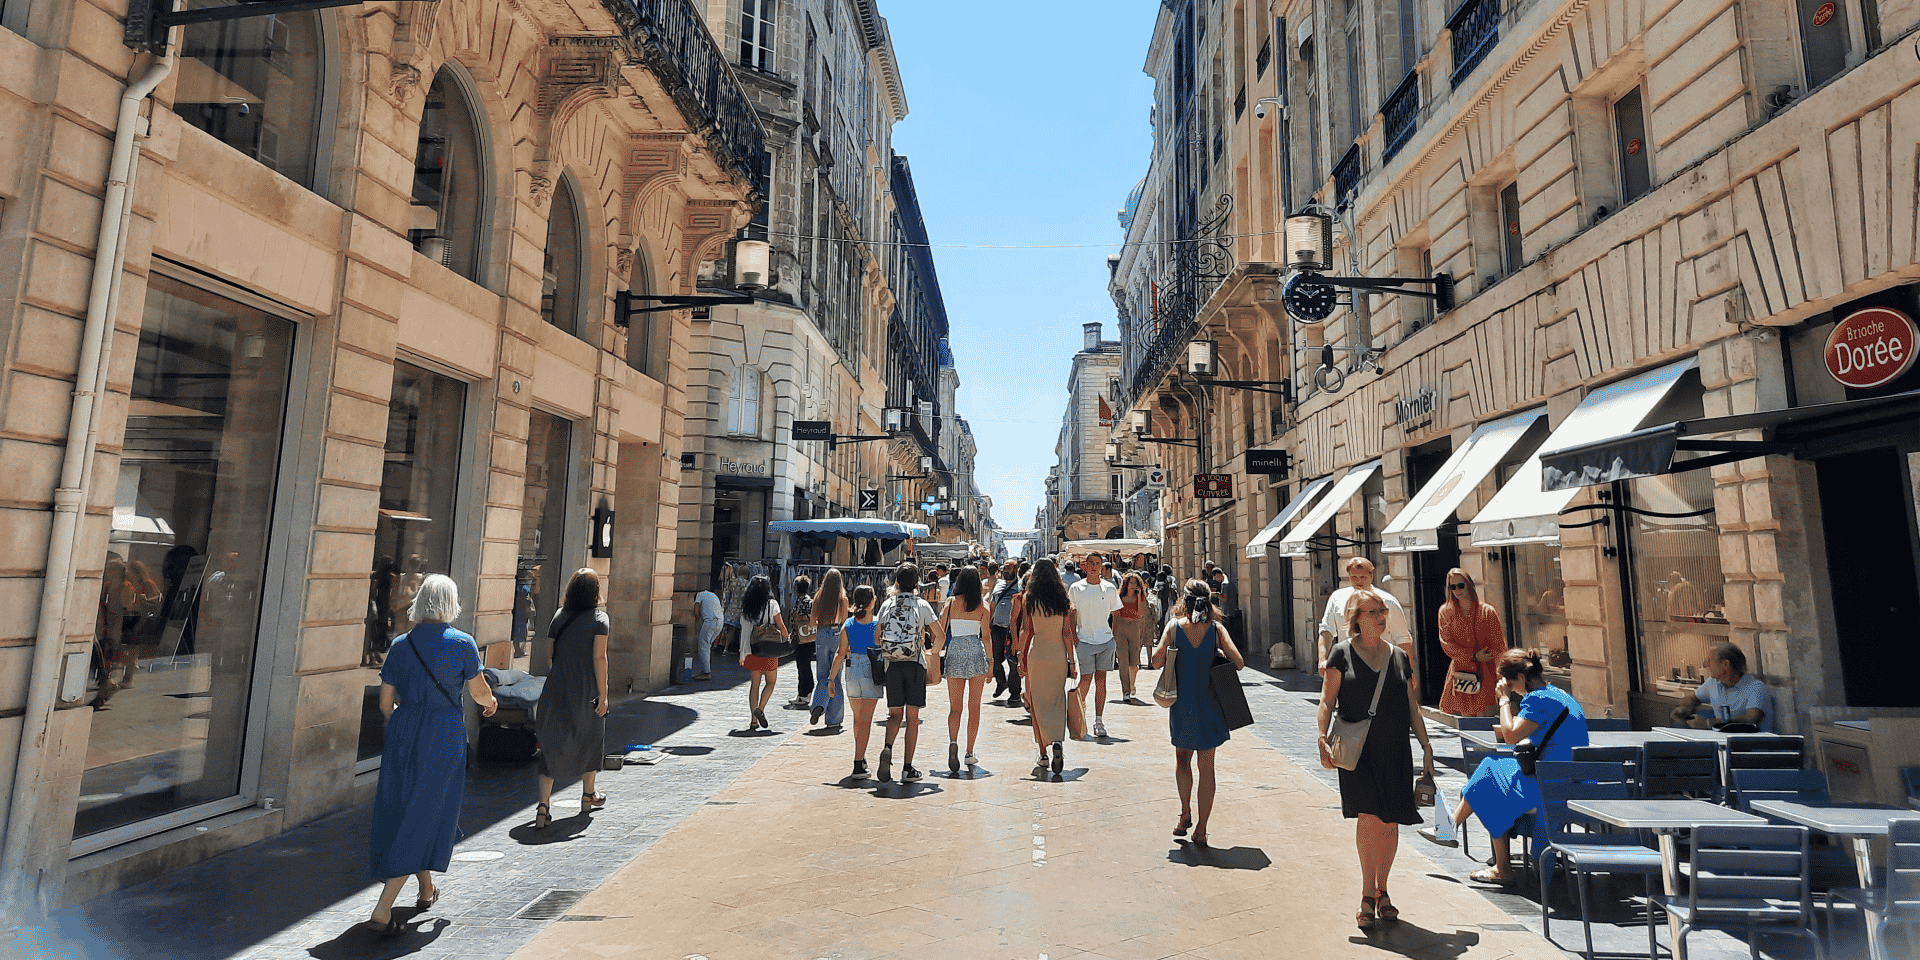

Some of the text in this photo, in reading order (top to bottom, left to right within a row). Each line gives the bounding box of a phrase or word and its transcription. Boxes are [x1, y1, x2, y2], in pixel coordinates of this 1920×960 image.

[1846, 320, 1885, 341] Brioche
[1834, 336, 1903, 374] Dorée
[1395, 388, 1434, 425] Mornier
[796, 426, 827, 434] Heyraud
[720, 457, 766, 475] Heyraud
[1252, 457, 1282, 467] minelli
[1207, 474, 1230, 482] TOQUE
